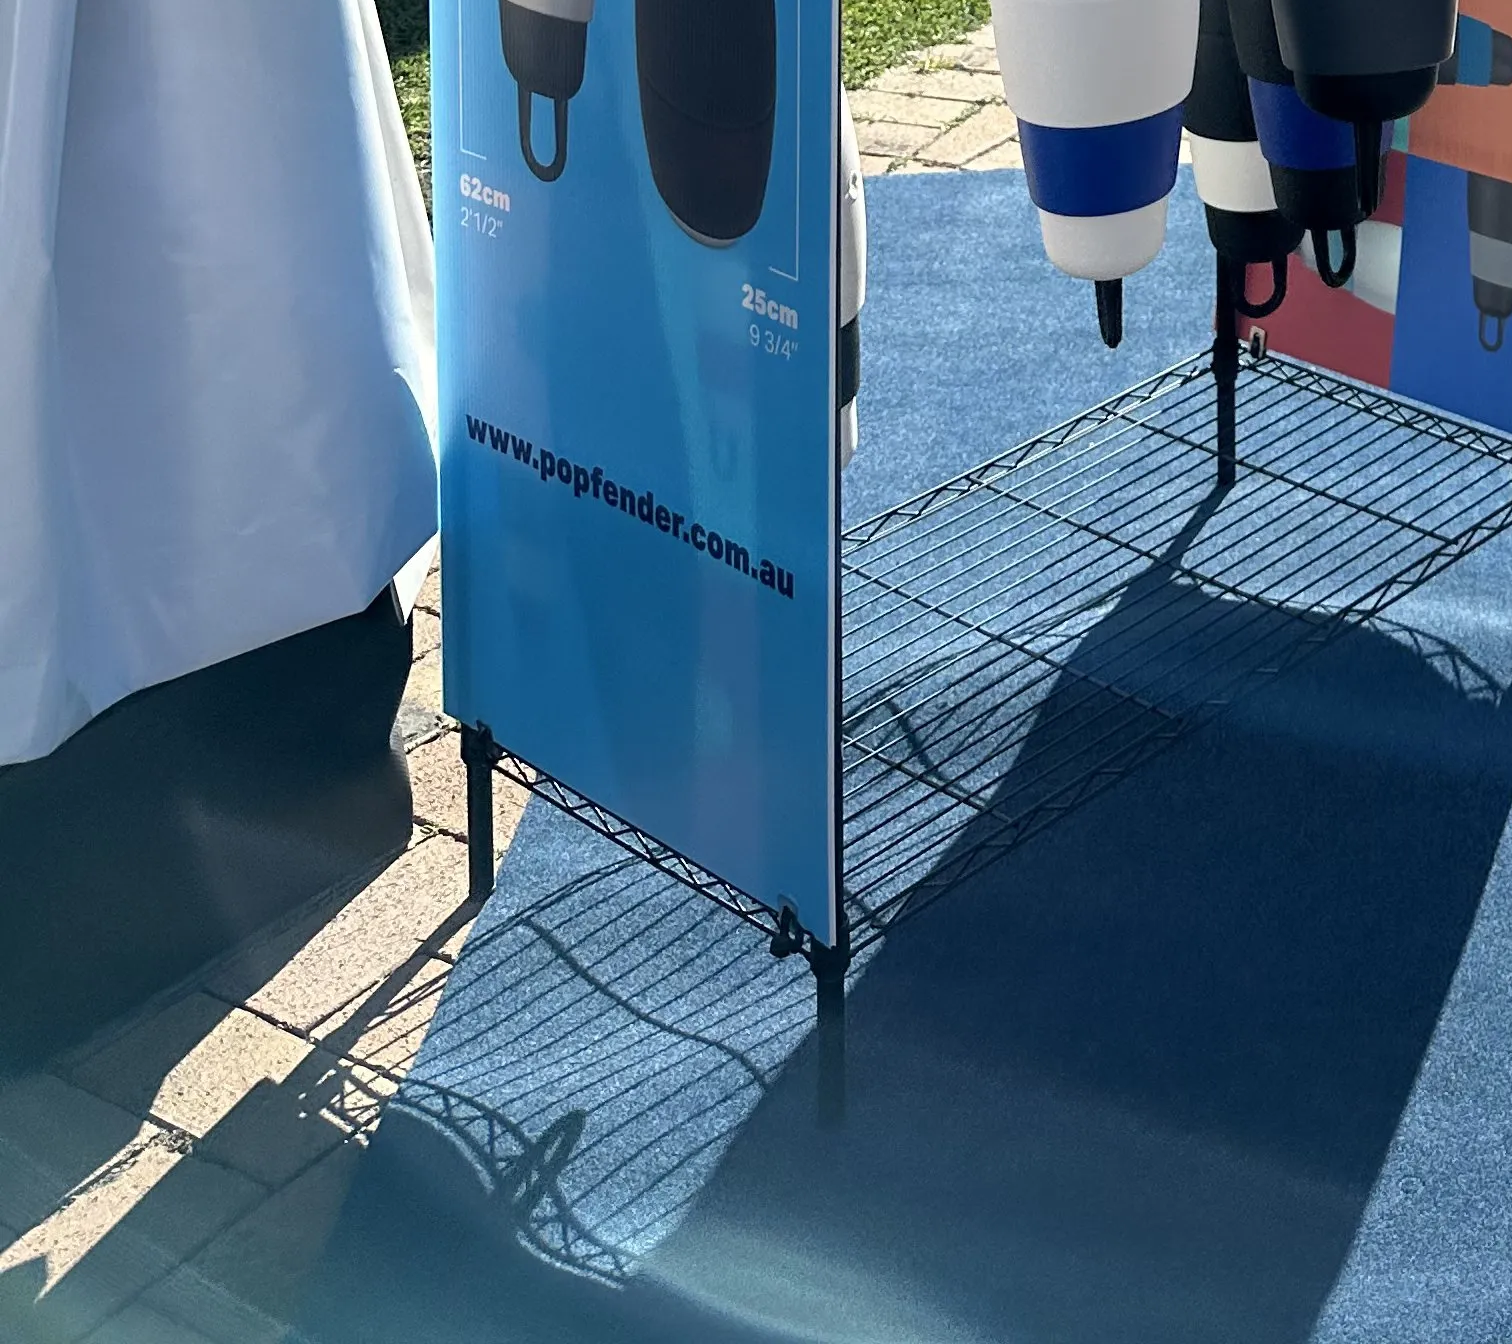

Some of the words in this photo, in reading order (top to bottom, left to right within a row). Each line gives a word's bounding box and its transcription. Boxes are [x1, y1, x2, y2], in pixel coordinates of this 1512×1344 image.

[460, 173, 511, 213] 62cm
[741, 283, 799, 330] 25cm
[749, 323, 760, 347] 9
[466, 413, 795, 600] www.popfender.com.au
